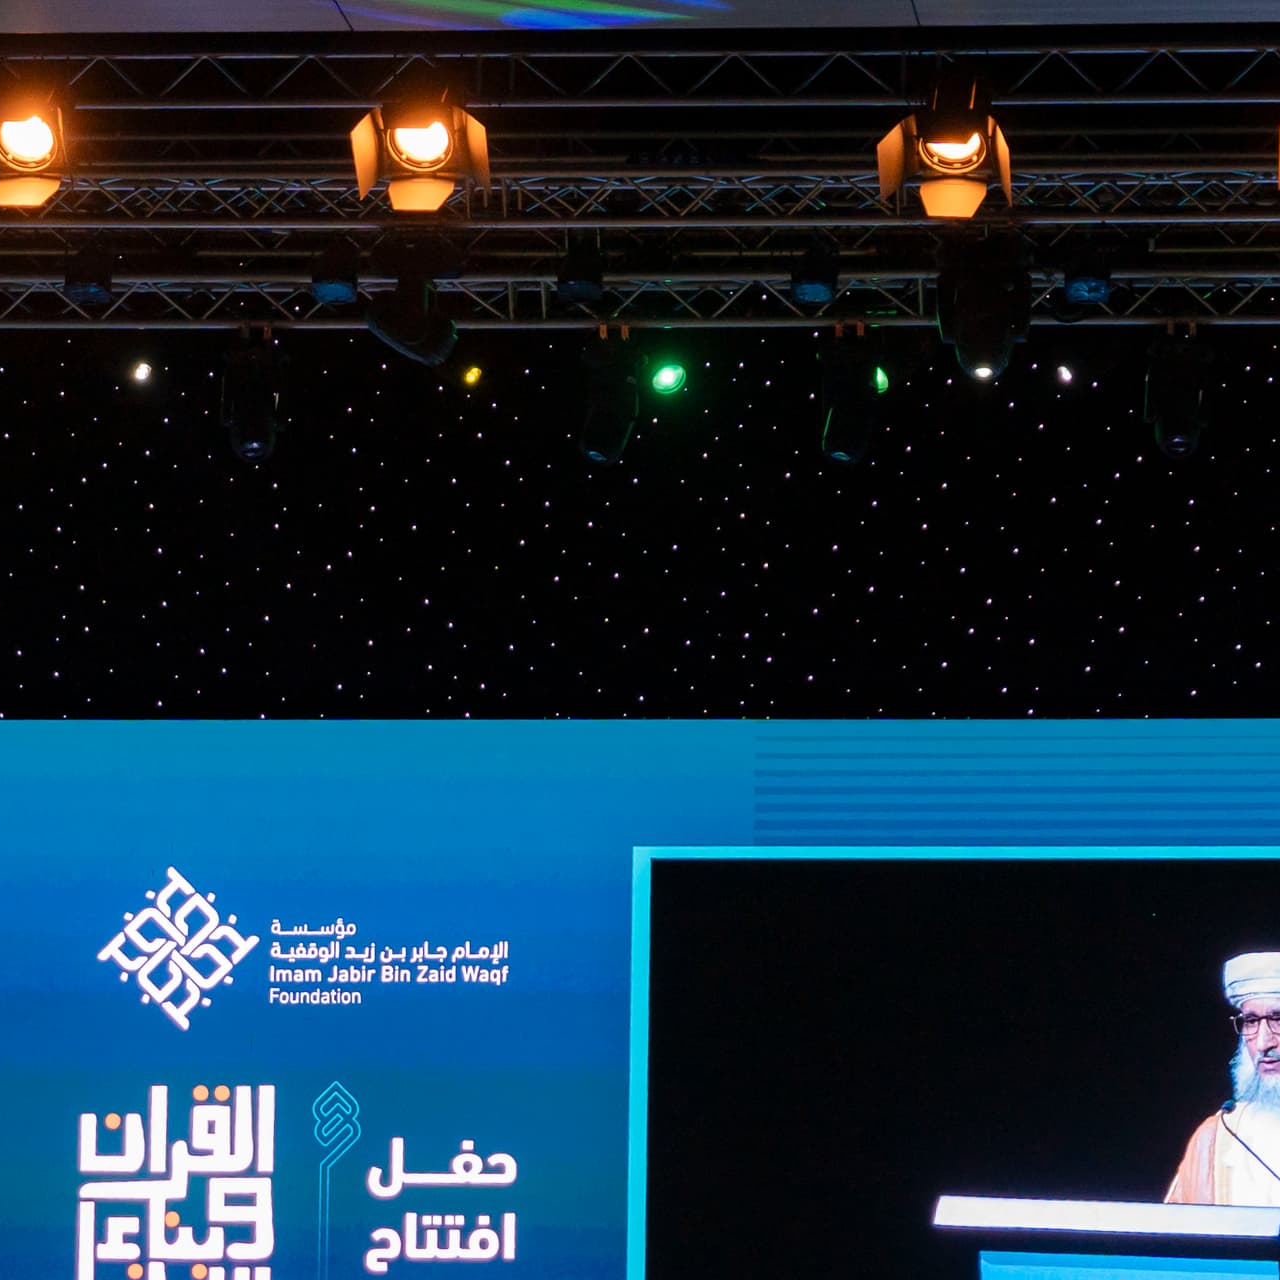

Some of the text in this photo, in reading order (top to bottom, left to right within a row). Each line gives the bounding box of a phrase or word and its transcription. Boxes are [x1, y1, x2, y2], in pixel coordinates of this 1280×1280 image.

[271, 918, 357, 939] مؤسسة
[271, 941, 508, 964] الإمام جابر بن زيد الوقفية
[269, 965, 509, 986] Imam Jabir Bin Zaid Waqf
[269, 987, 362, 1004] Foundation
[367, 1137, 518, 1197] حفل
[365, 1212, 516, 1274] افتتاح
